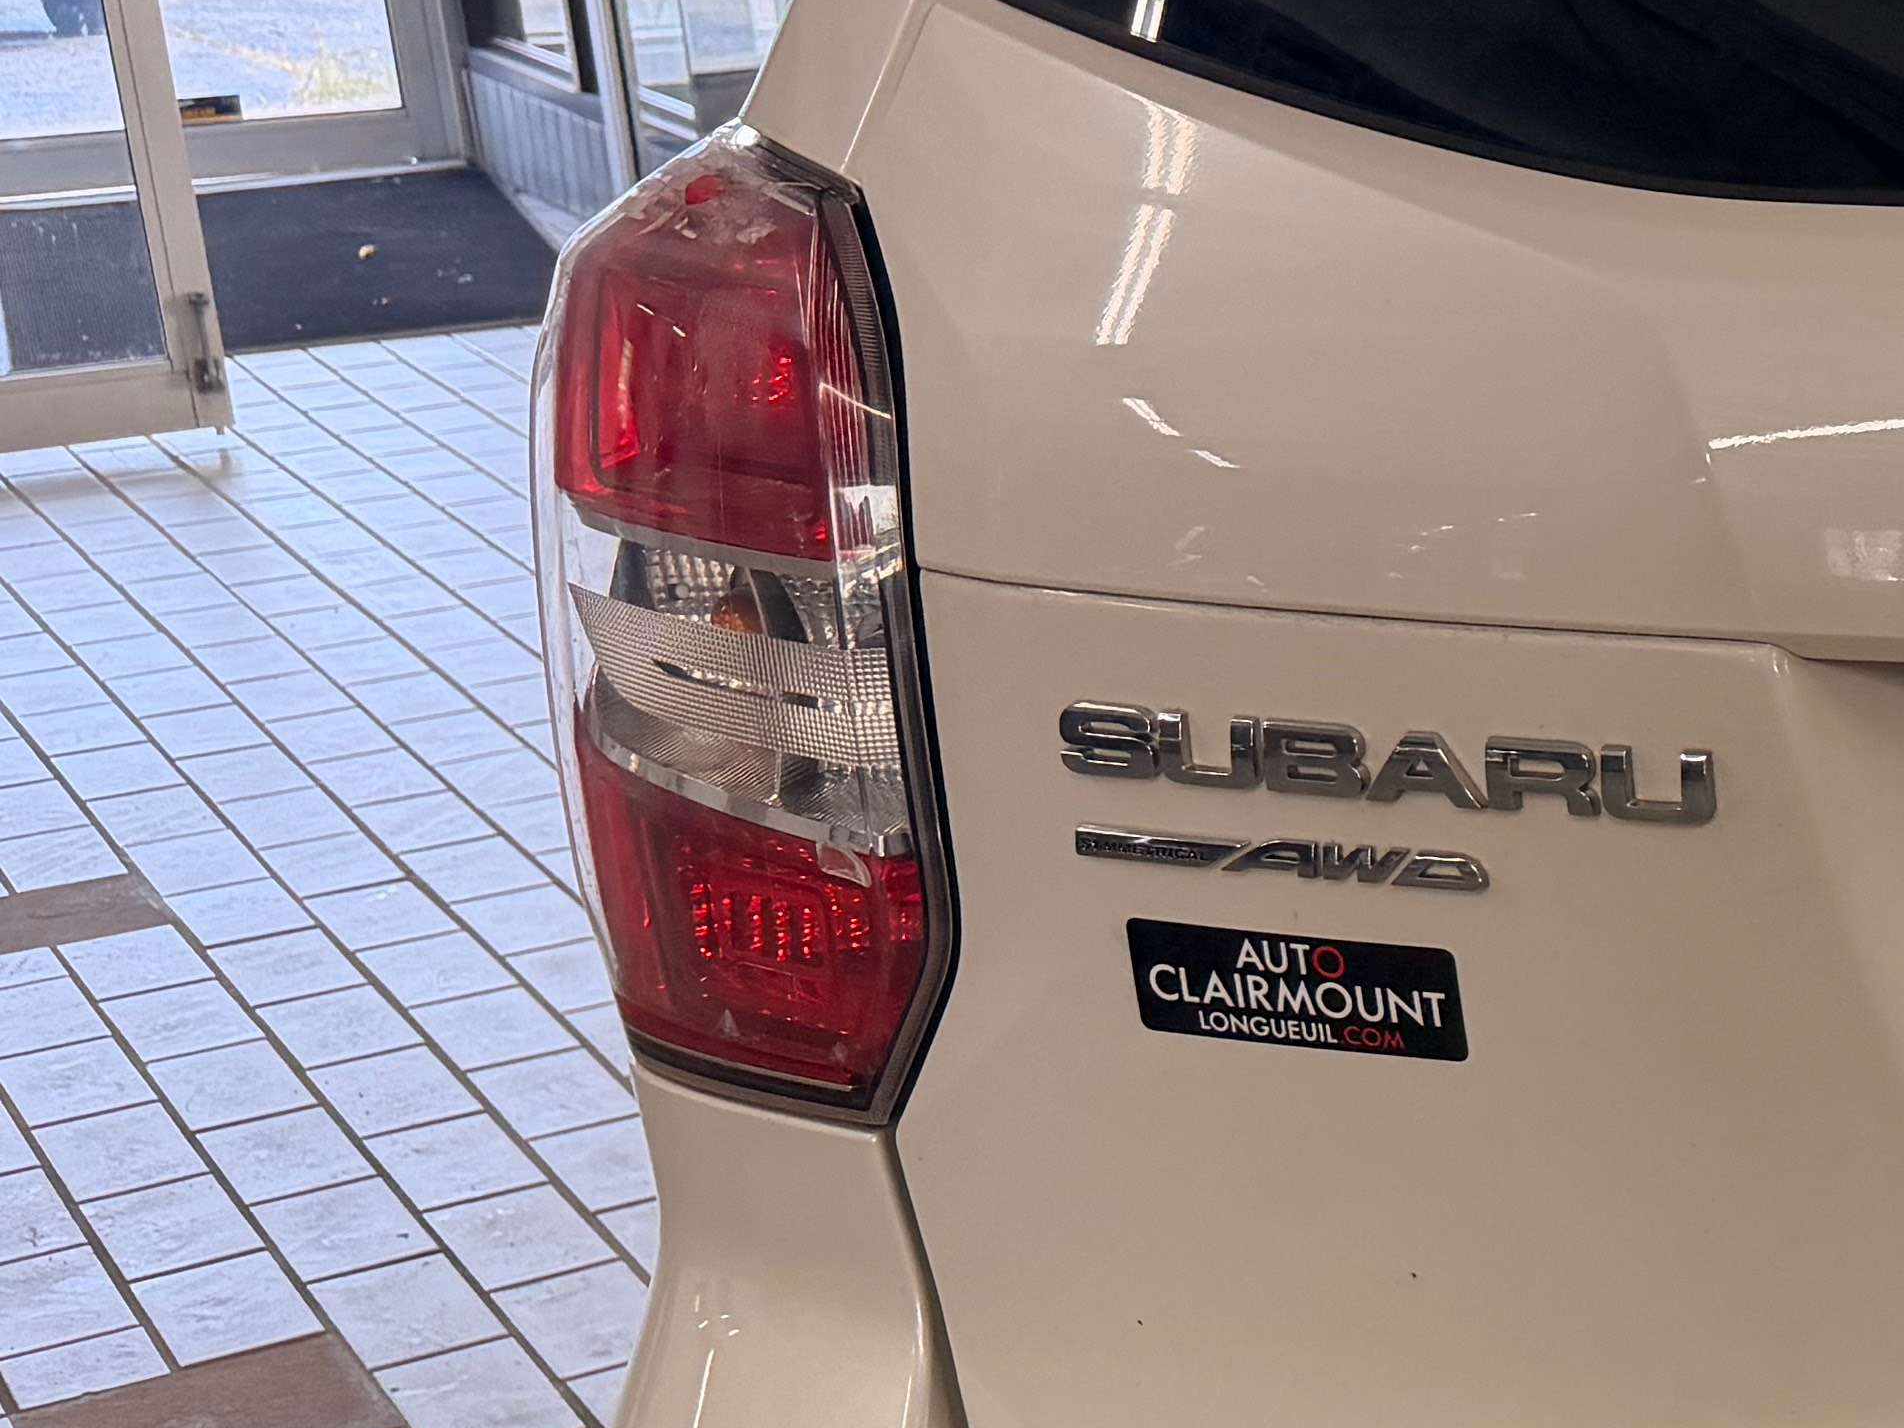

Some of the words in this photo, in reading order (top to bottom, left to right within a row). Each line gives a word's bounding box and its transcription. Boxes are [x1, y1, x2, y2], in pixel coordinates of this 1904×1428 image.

[1058, 698, 1718, 826] SUBARU
[1221, 838, 1491, 892] AWD
[1236, 937, 1346, 979] AUTO
[1149, 963, 1446, 1029] CLAIRMOUNT
[1198, 1010, 1406, 1050] LONGUEUIL.COM
